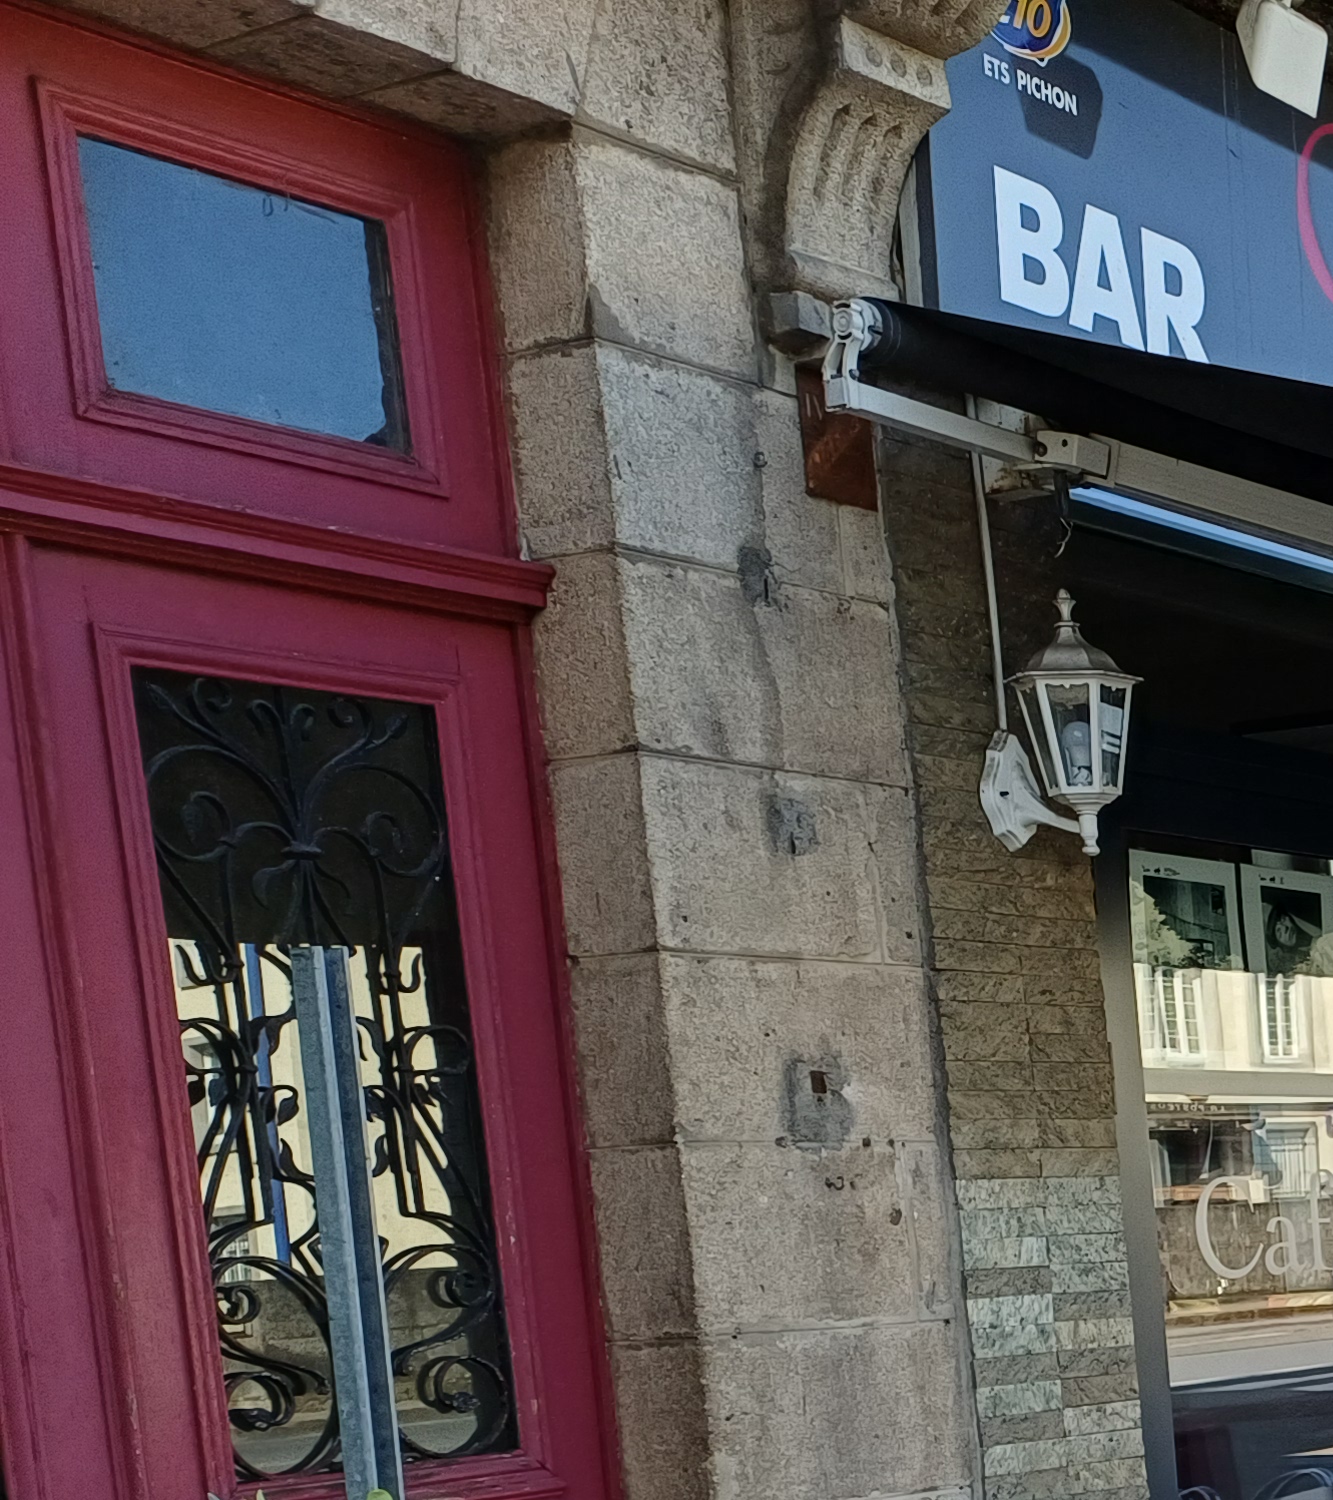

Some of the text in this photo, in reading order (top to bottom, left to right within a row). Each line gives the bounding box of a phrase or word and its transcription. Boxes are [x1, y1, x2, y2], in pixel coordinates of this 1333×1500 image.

[983, 53, 1077, 116] ETS PICHON
[994, 165, 1209, 364] BAR
